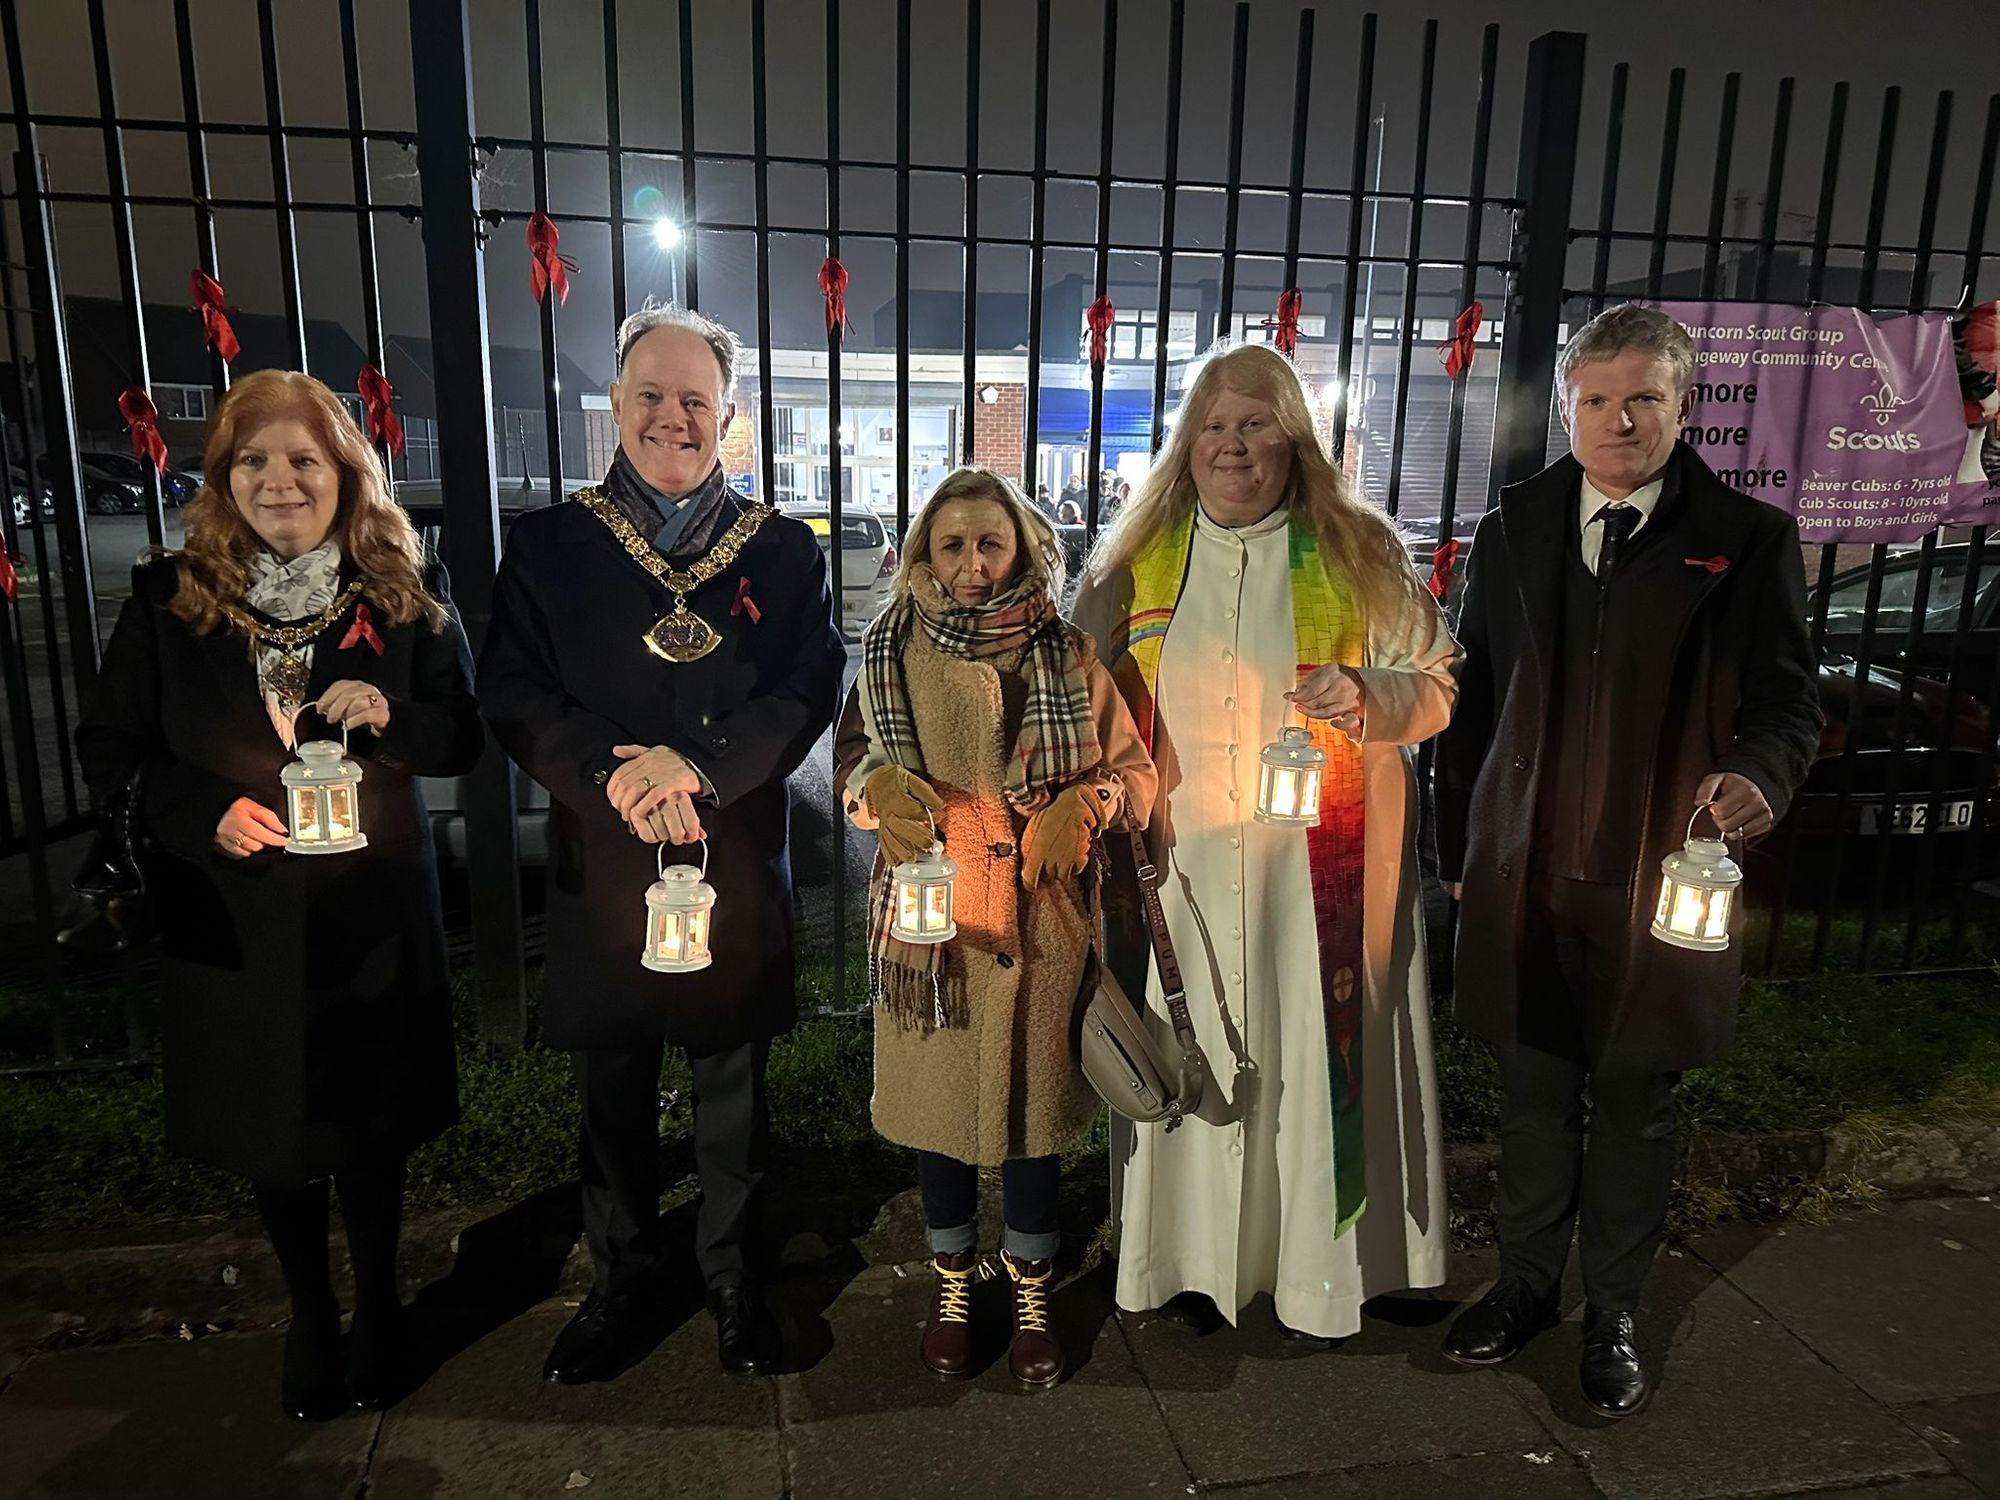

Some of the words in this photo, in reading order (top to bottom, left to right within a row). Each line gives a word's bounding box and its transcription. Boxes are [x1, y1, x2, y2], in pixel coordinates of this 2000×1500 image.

[1746, 325, 1787, 340] Scout
[1790, 326, 1844, 346] Group
[1695, 350, 1749, 368] geway
[1752, 350, 1845, 370] Community
[1680, 426, 1748, 446] more
[1826, 426, 1921, 451] Scouts
[1717, 468, 1787, 488] more
[1801, 479, 1848, 491] Beaver
[1851, 479, 1892, 492] Cubs:
[1893, 480, 1901, 491] 6
[1911, 478, 1935, 492] 7yrs
[1937, 474, 1953, 487] old
[1798, 497, 1824, 509] Cub
[1827, 497, 1879, 510] Scouts:
[1881, 498, 1890, 509] 8
[1900, 497, 1931, 509] 10yrs
[1933, 492, 1949, 506] old
[1797, 515, 1832, 530] Open
[1836, 517, 1851, 527] to
[1854, 515, 1883, 530] Boys
[1885, 513, 1909, 525] and
[1911, 511, 1938, 524] Girls
[1157, 930, 1183, 994] PUM
